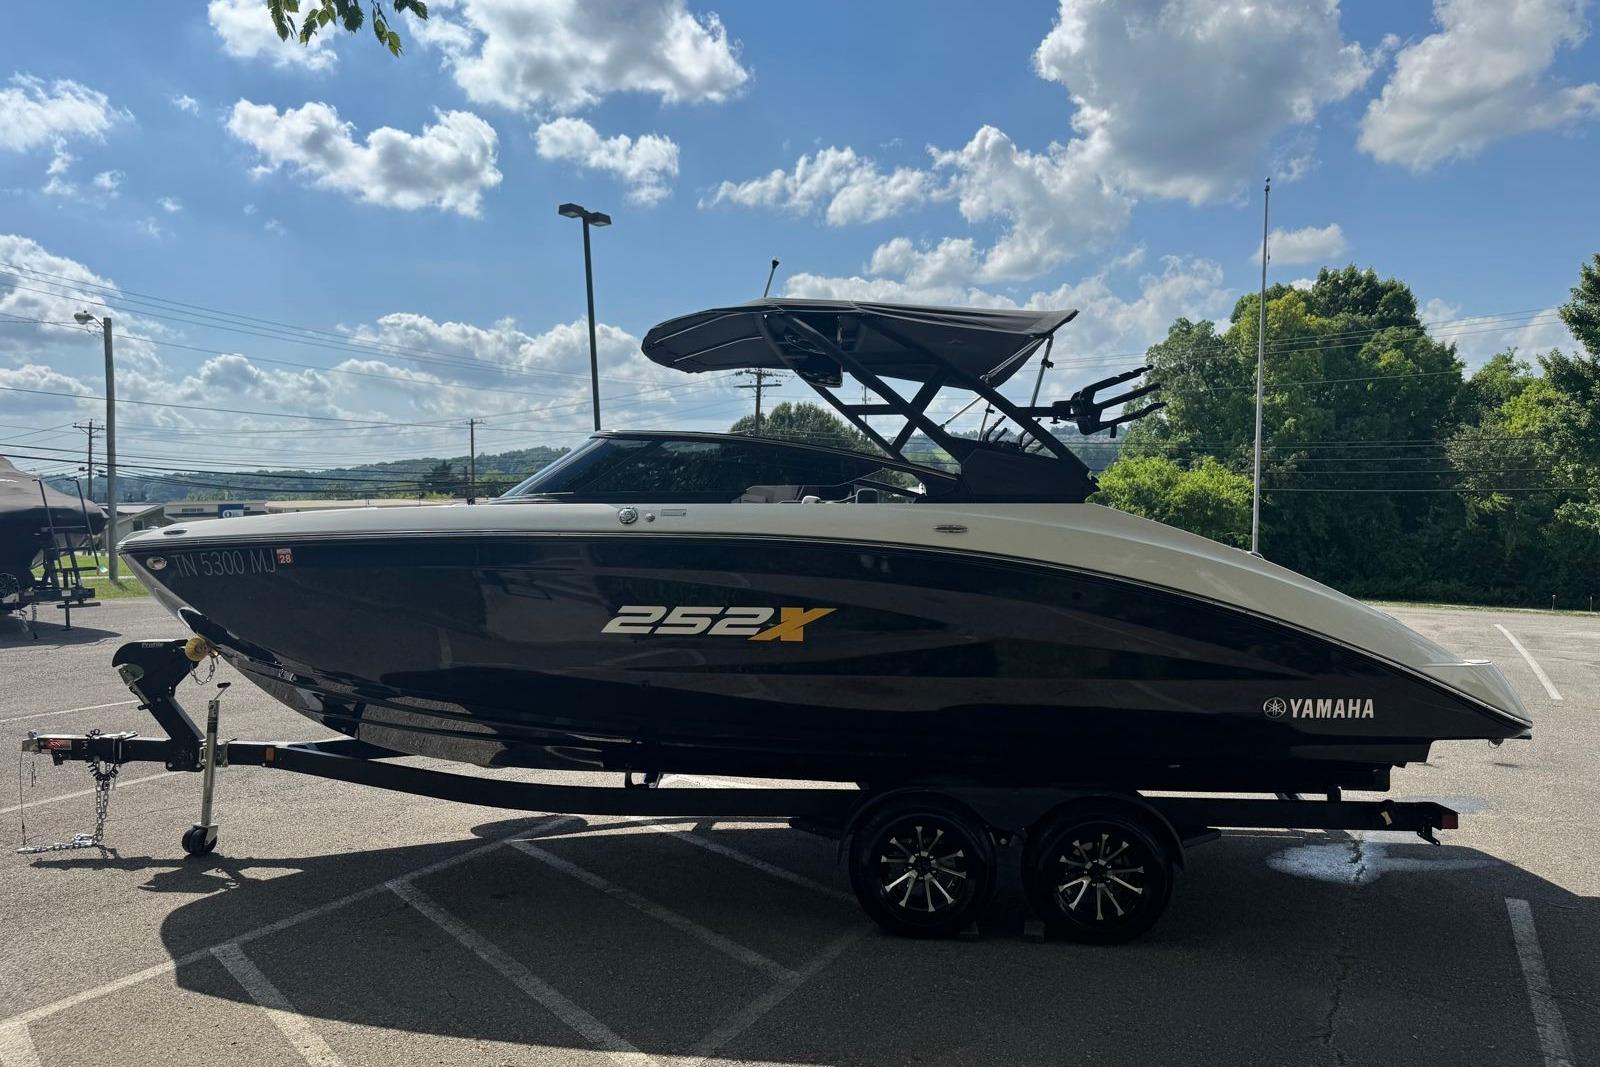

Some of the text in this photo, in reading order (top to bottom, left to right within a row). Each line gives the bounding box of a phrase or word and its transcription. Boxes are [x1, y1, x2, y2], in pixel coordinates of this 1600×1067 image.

[171, 548, 276, 577] TN 5300 MJ
[279, 554, 292, 564] 28
[600, 605, 838, 642] 252X
[1289, 698, 1375, 719] YAMAHA
